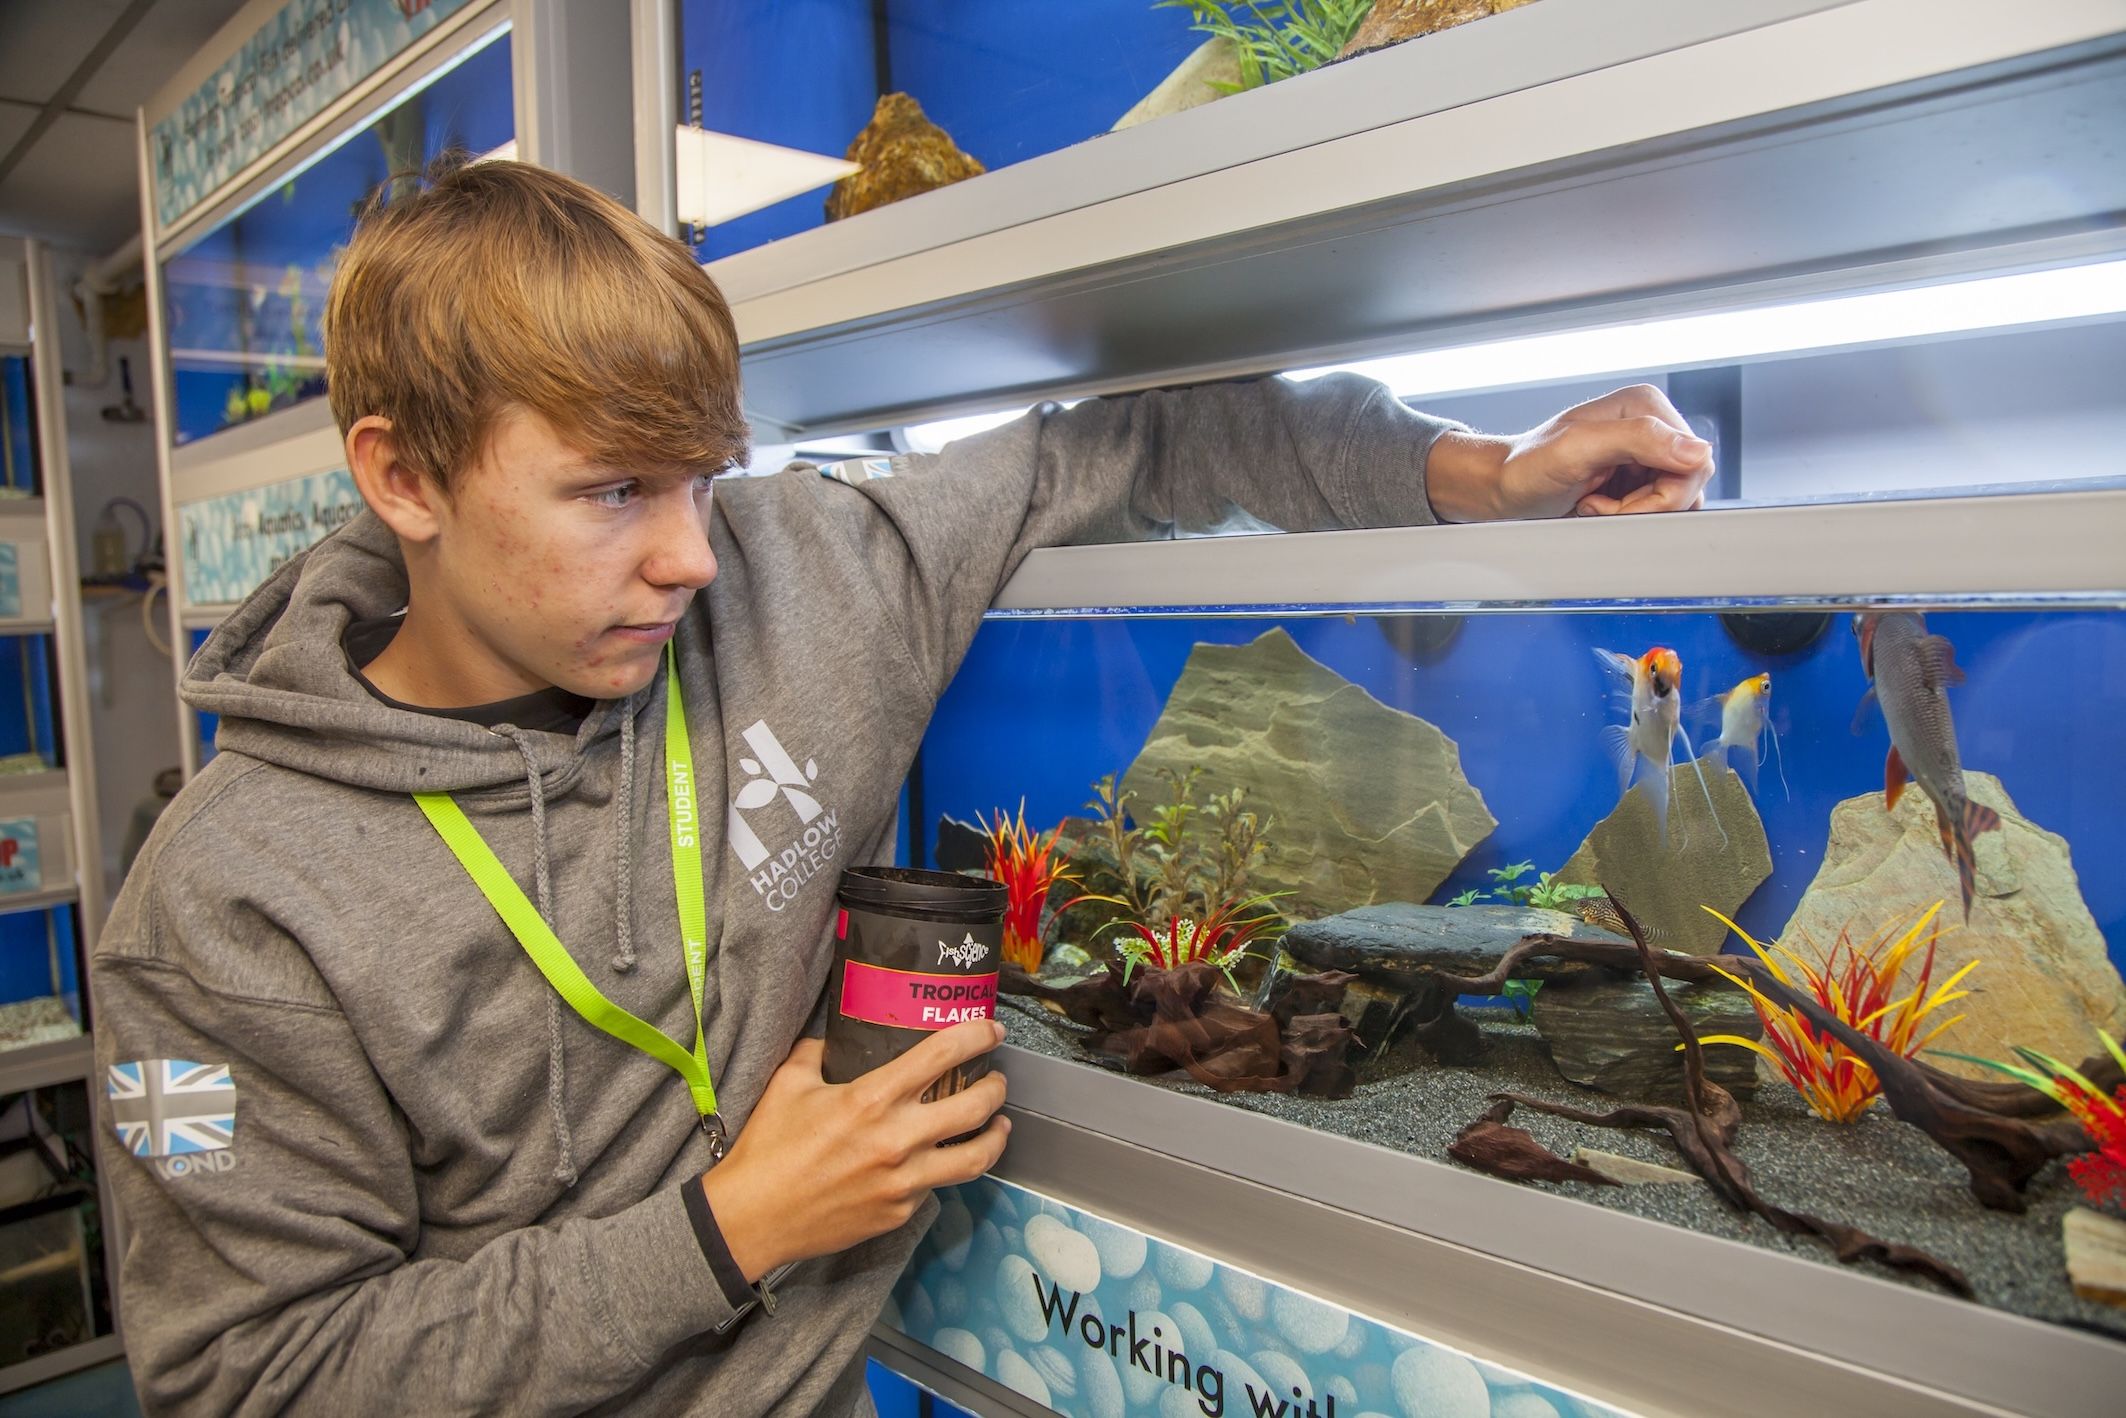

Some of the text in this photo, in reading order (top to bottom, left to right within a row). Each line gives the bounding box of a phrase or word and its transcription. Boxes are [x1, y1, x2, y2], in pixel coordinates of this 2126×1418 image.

[672, 760, 695, 848] STUDENT
[750, 808, 837, 895] HADLOW
[909, 983, 994, 1001] TROPICAL
[922, 1005, 987, 1023] FLAKES
[1032, 1272, 1224, 1418] Working
